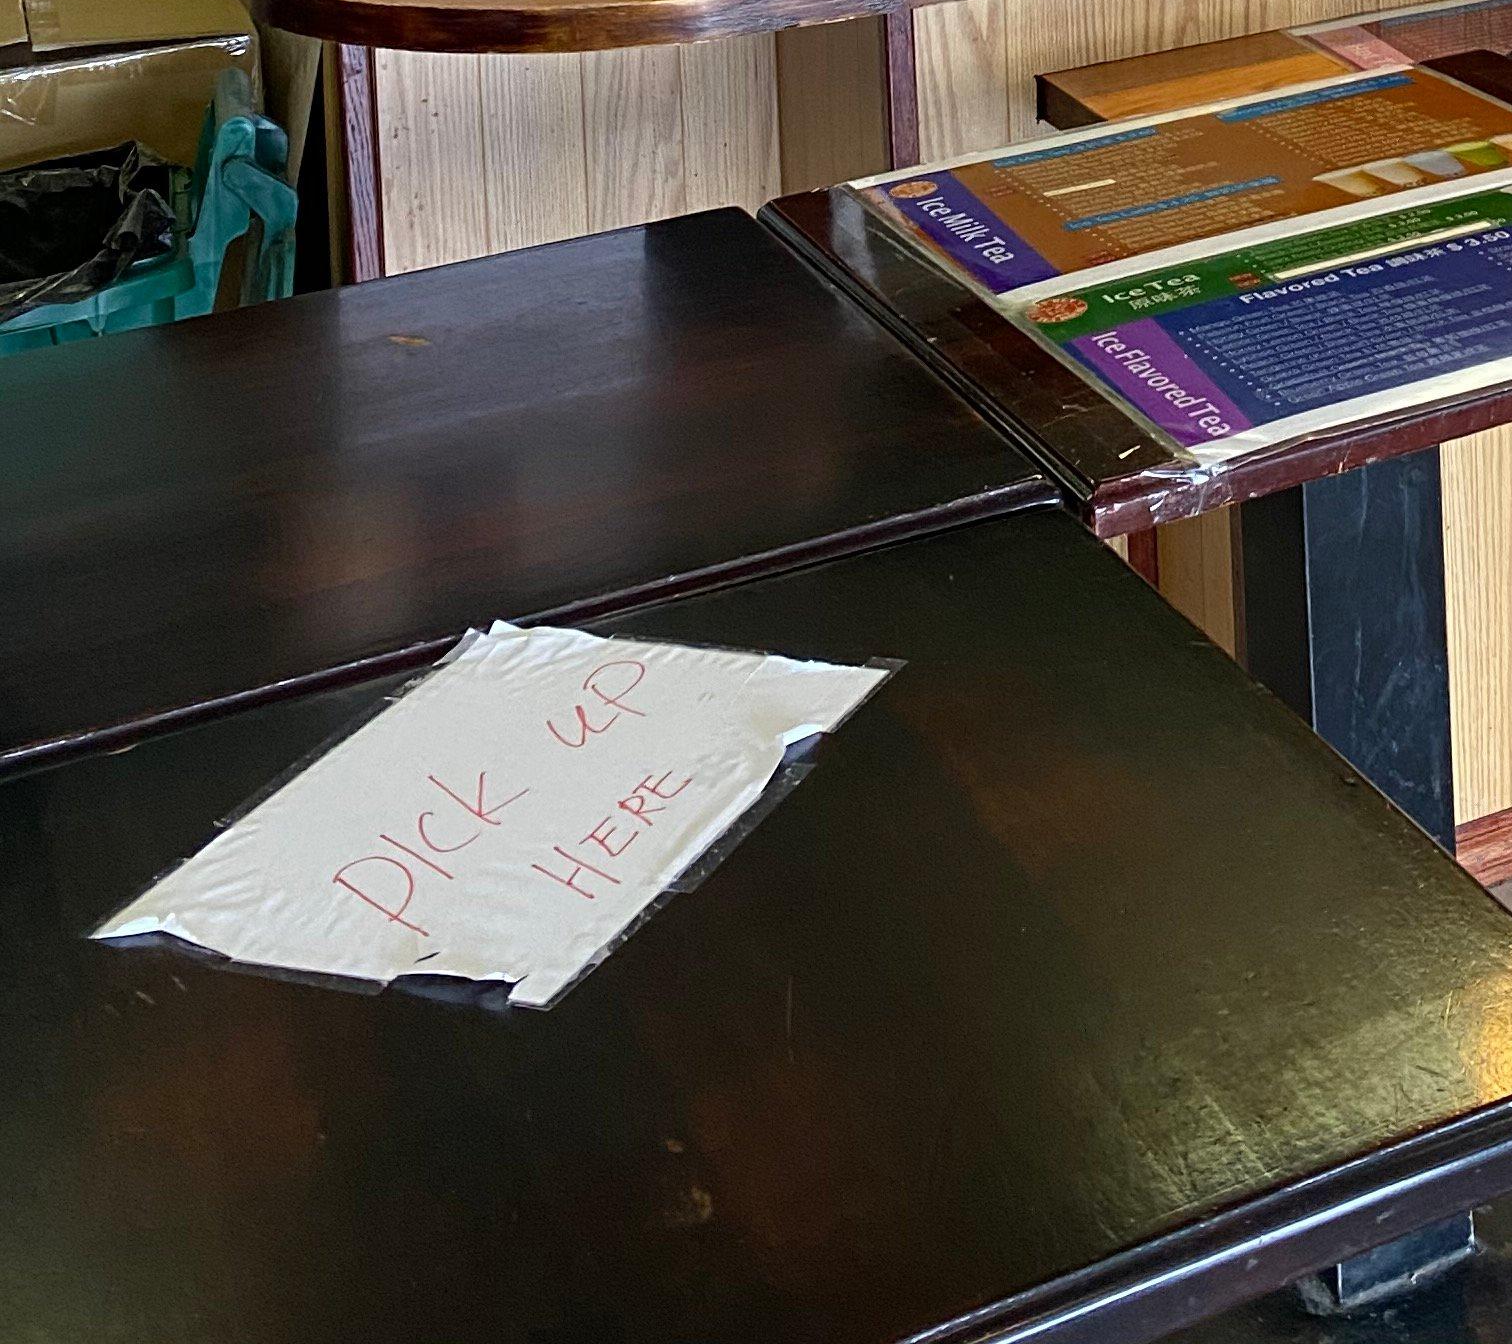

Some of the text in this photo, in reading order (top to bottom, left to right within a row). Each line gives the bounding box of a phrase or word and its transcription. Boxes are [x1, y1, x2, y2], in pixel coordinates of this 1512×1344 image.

[915, 194, 1014, 266] Ice Milk Tea
[1240, 273, 1340, 305] Flavored
[1346, 262, 1383, 279] Tea
[1466, 229, 1510, 251] 3.50
[1102, 272, 1201, 305] Ice Tea
[1092, 332, 1125, 356] Ice
[1116, 348, 1206, 408] Flavored
[1187, 401, 1232, 439] Tea
[334, 771, 530, 937] PICK
[533, 769, 692, 899] HERE
